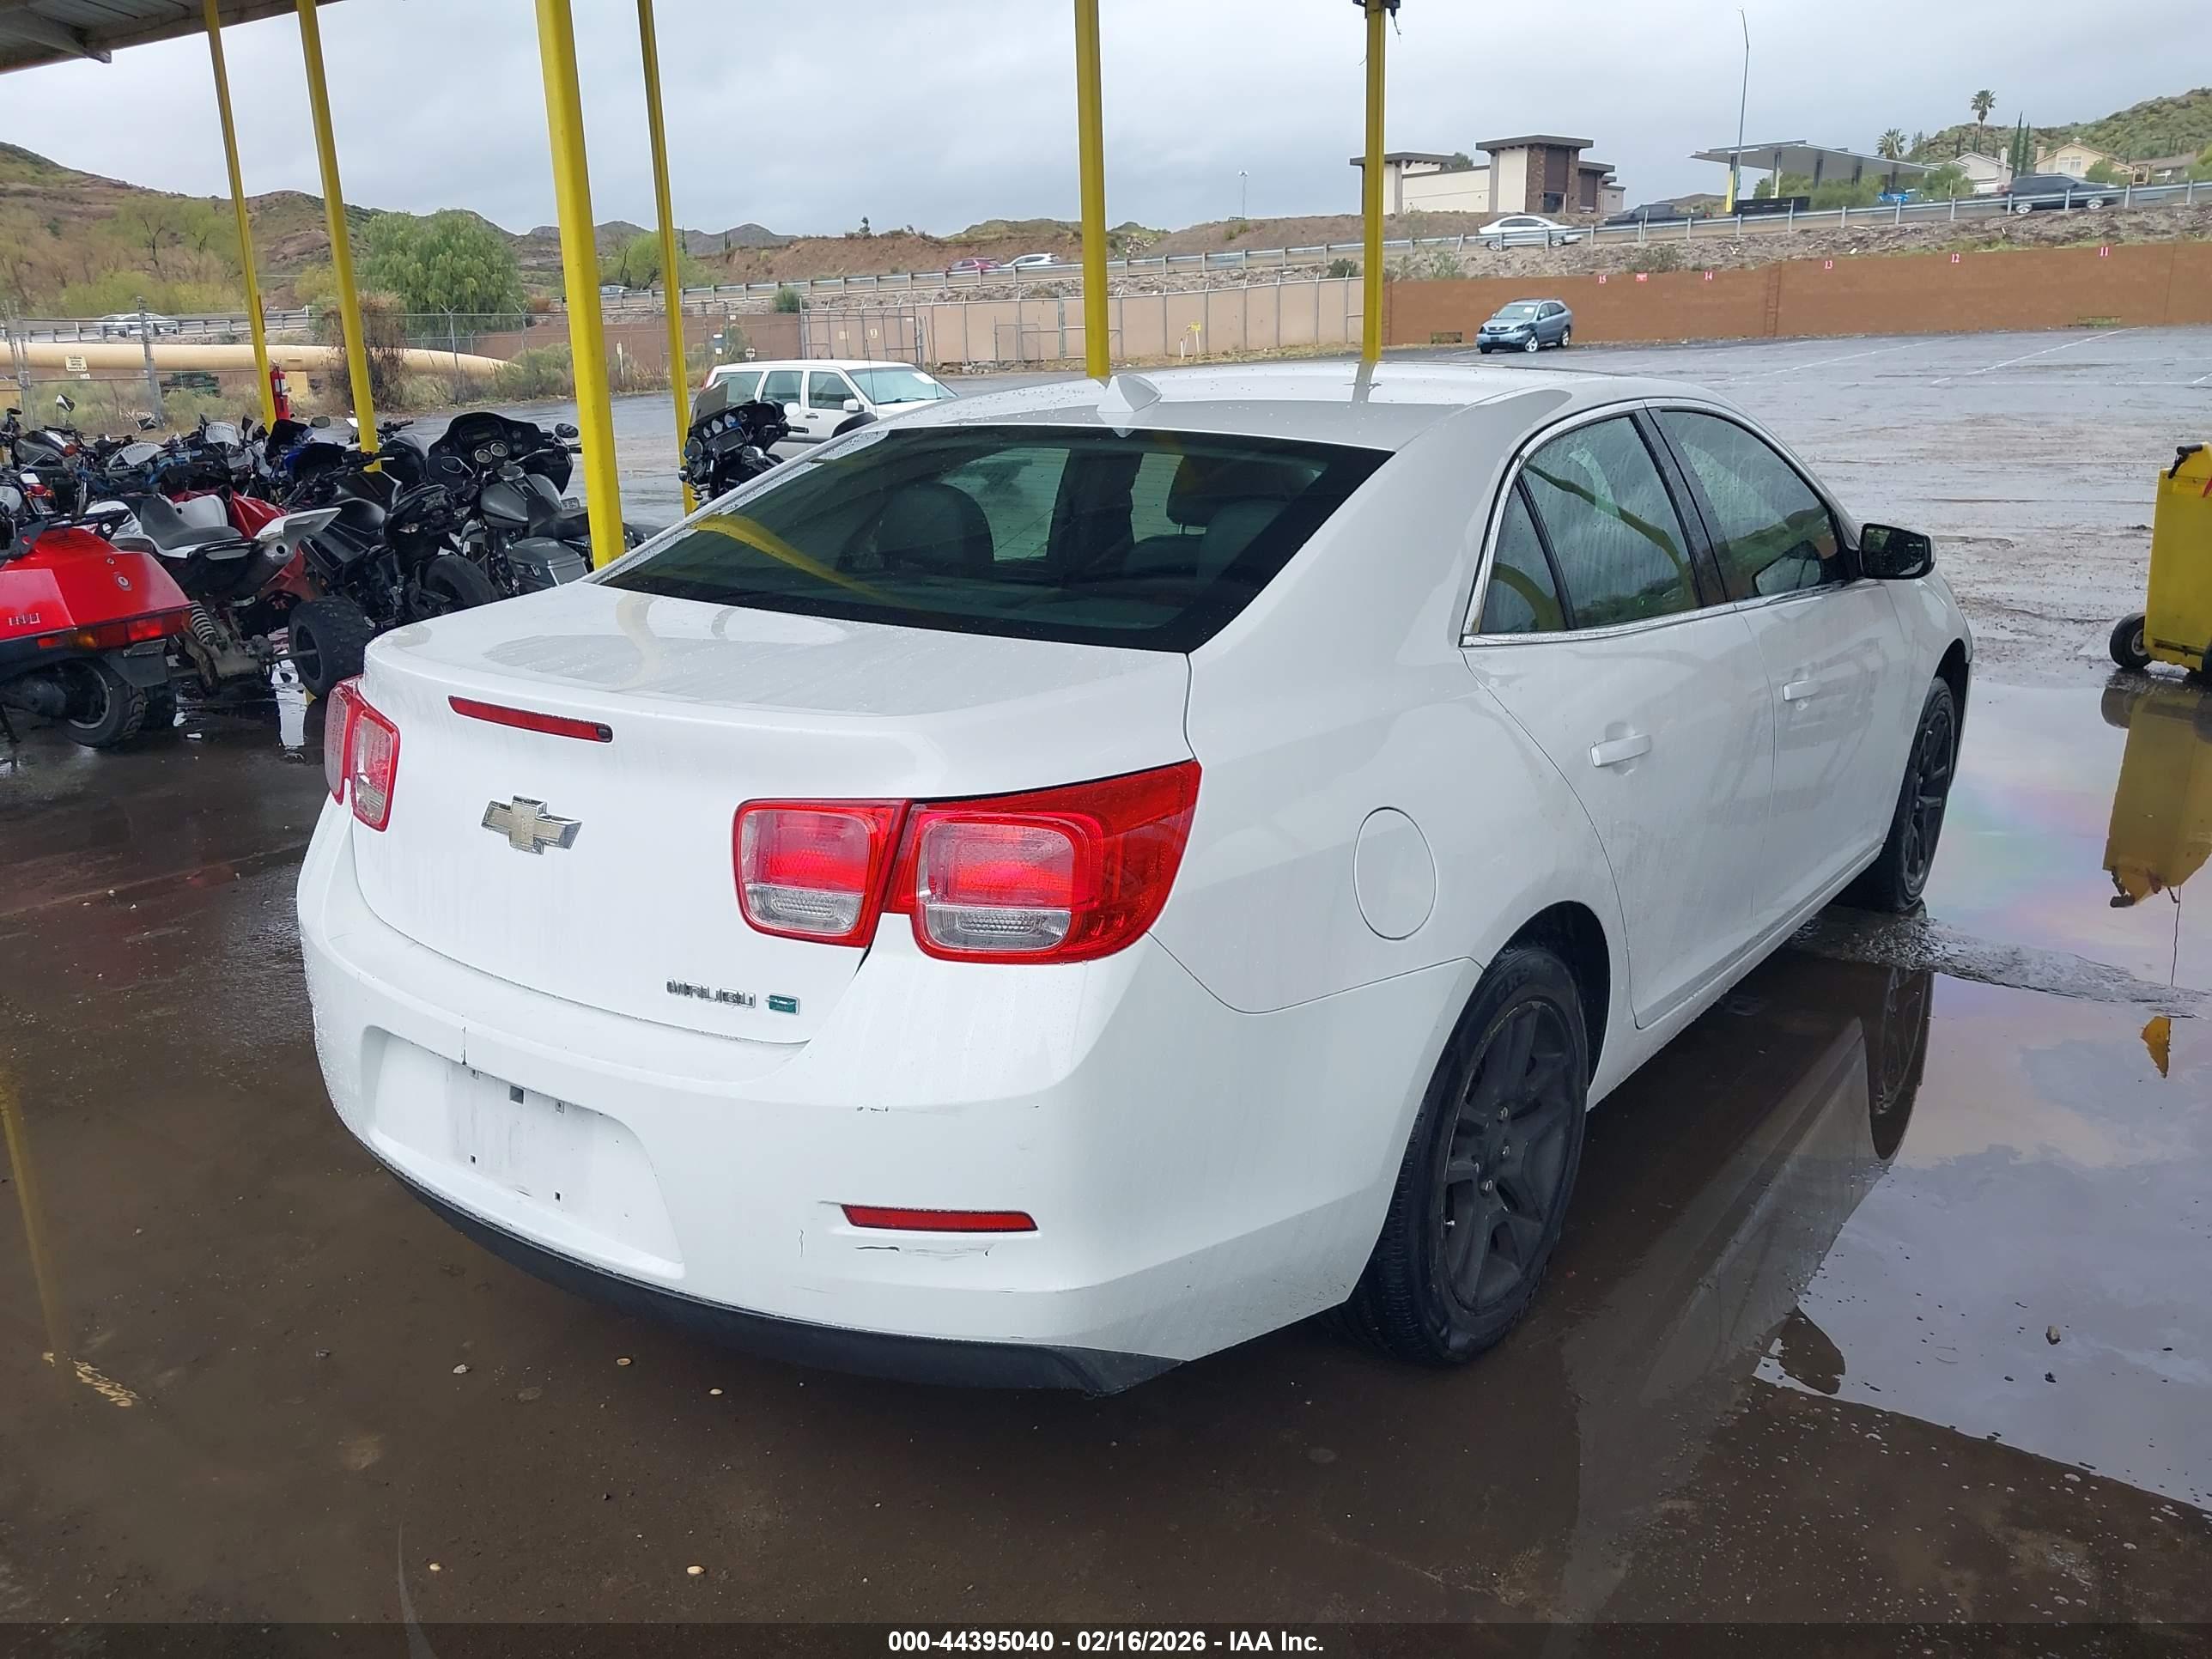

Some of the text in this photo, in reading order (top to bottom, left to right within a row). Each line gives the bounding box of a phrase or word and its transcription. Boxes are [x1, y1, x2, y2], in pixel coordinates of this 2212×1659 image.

[2100, 246, 2109, 257] 11
[1951, 253, 1960, 263] 12
[1824, 260, 1833, 269] 13
[1598, 275, 1607, 283] 15
[1705, 271, 1713, 281] 14
